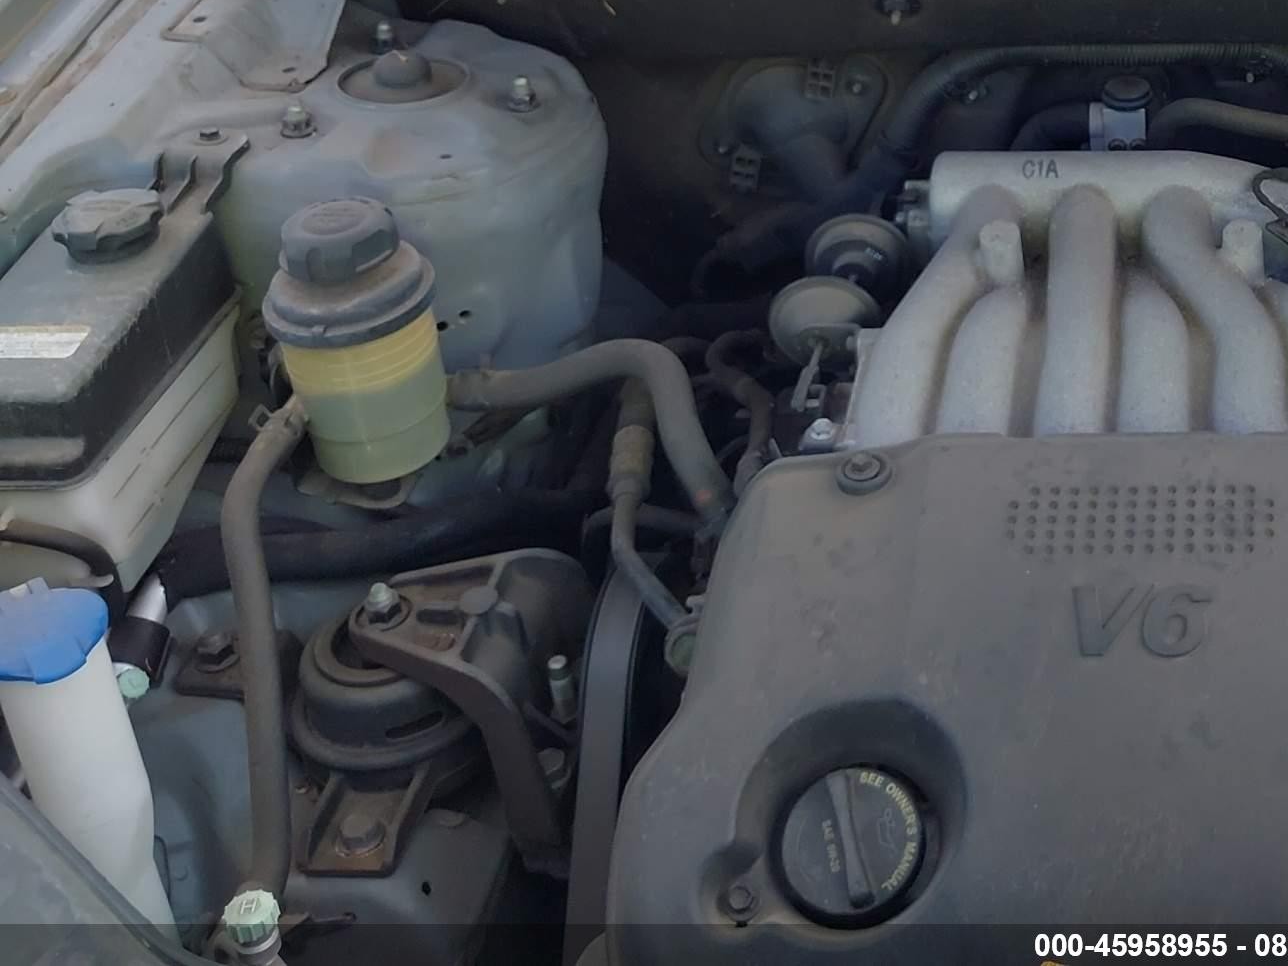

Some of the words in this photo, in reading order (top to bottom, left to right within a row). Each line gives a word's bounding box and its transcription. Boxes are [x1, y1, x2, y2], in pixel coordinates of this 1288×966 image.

[1071, 584, 1213, 658] V6
[859, 771, 884, 787] SEE
[881, 841, 917, 891] MANUAL
[240, 897, 258, 914] H
